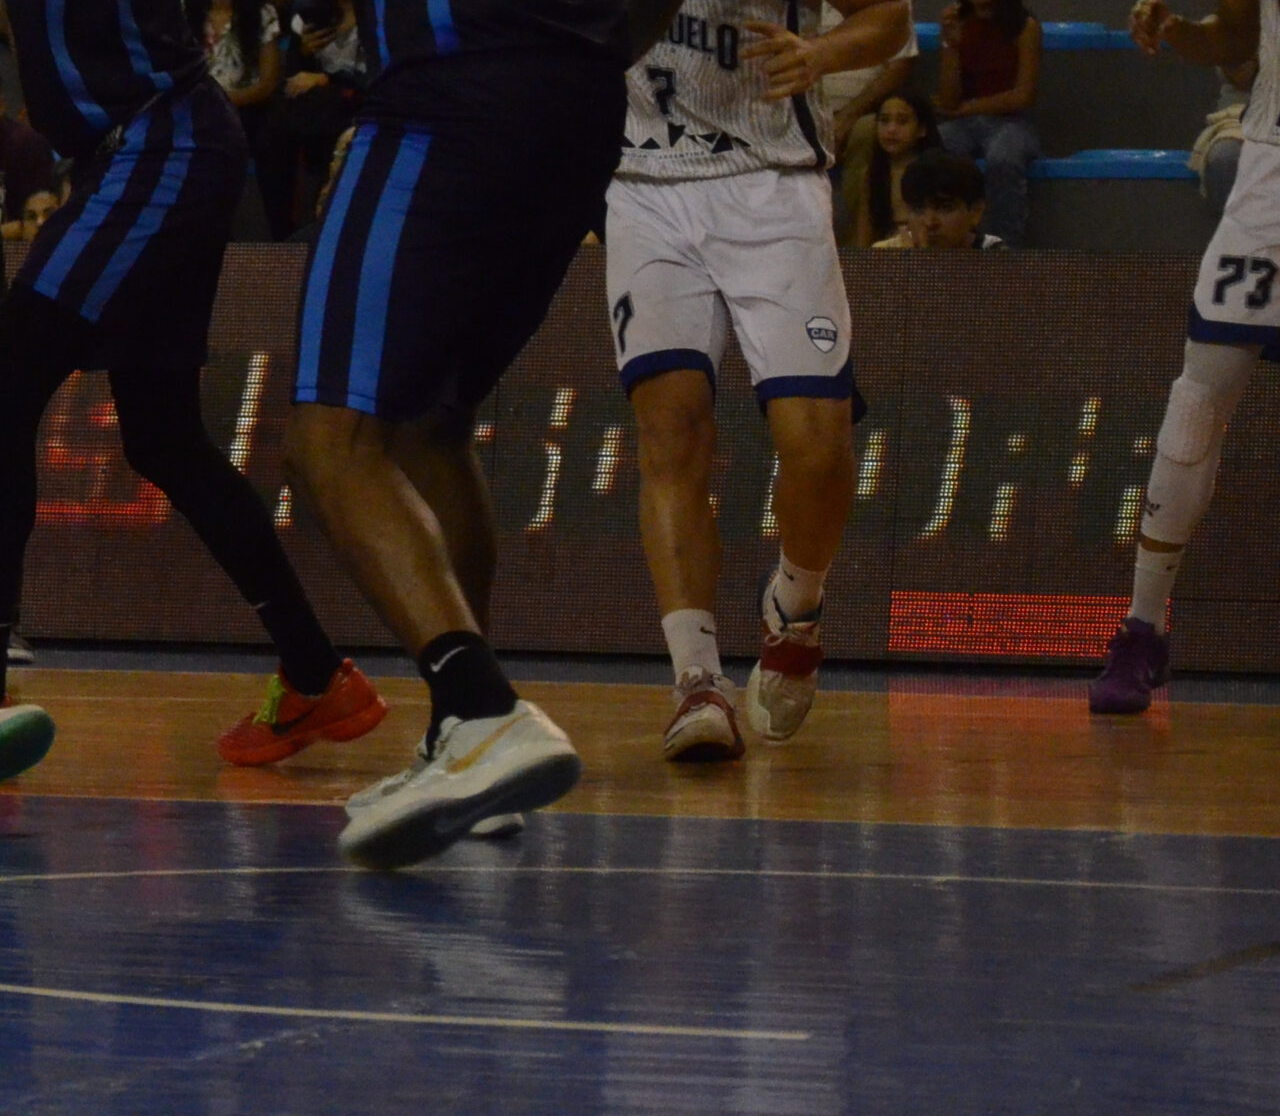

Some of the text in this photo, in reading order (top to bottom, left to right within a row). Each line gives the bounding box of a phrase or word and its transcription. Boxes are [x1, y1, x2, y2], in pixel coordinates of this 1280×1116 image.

[647, 64, 676, 116] 7
[1212, 254, 1278, 309] 73
[612, 290, 634, 354] 7
[810, 328, 836, 341] CAR
